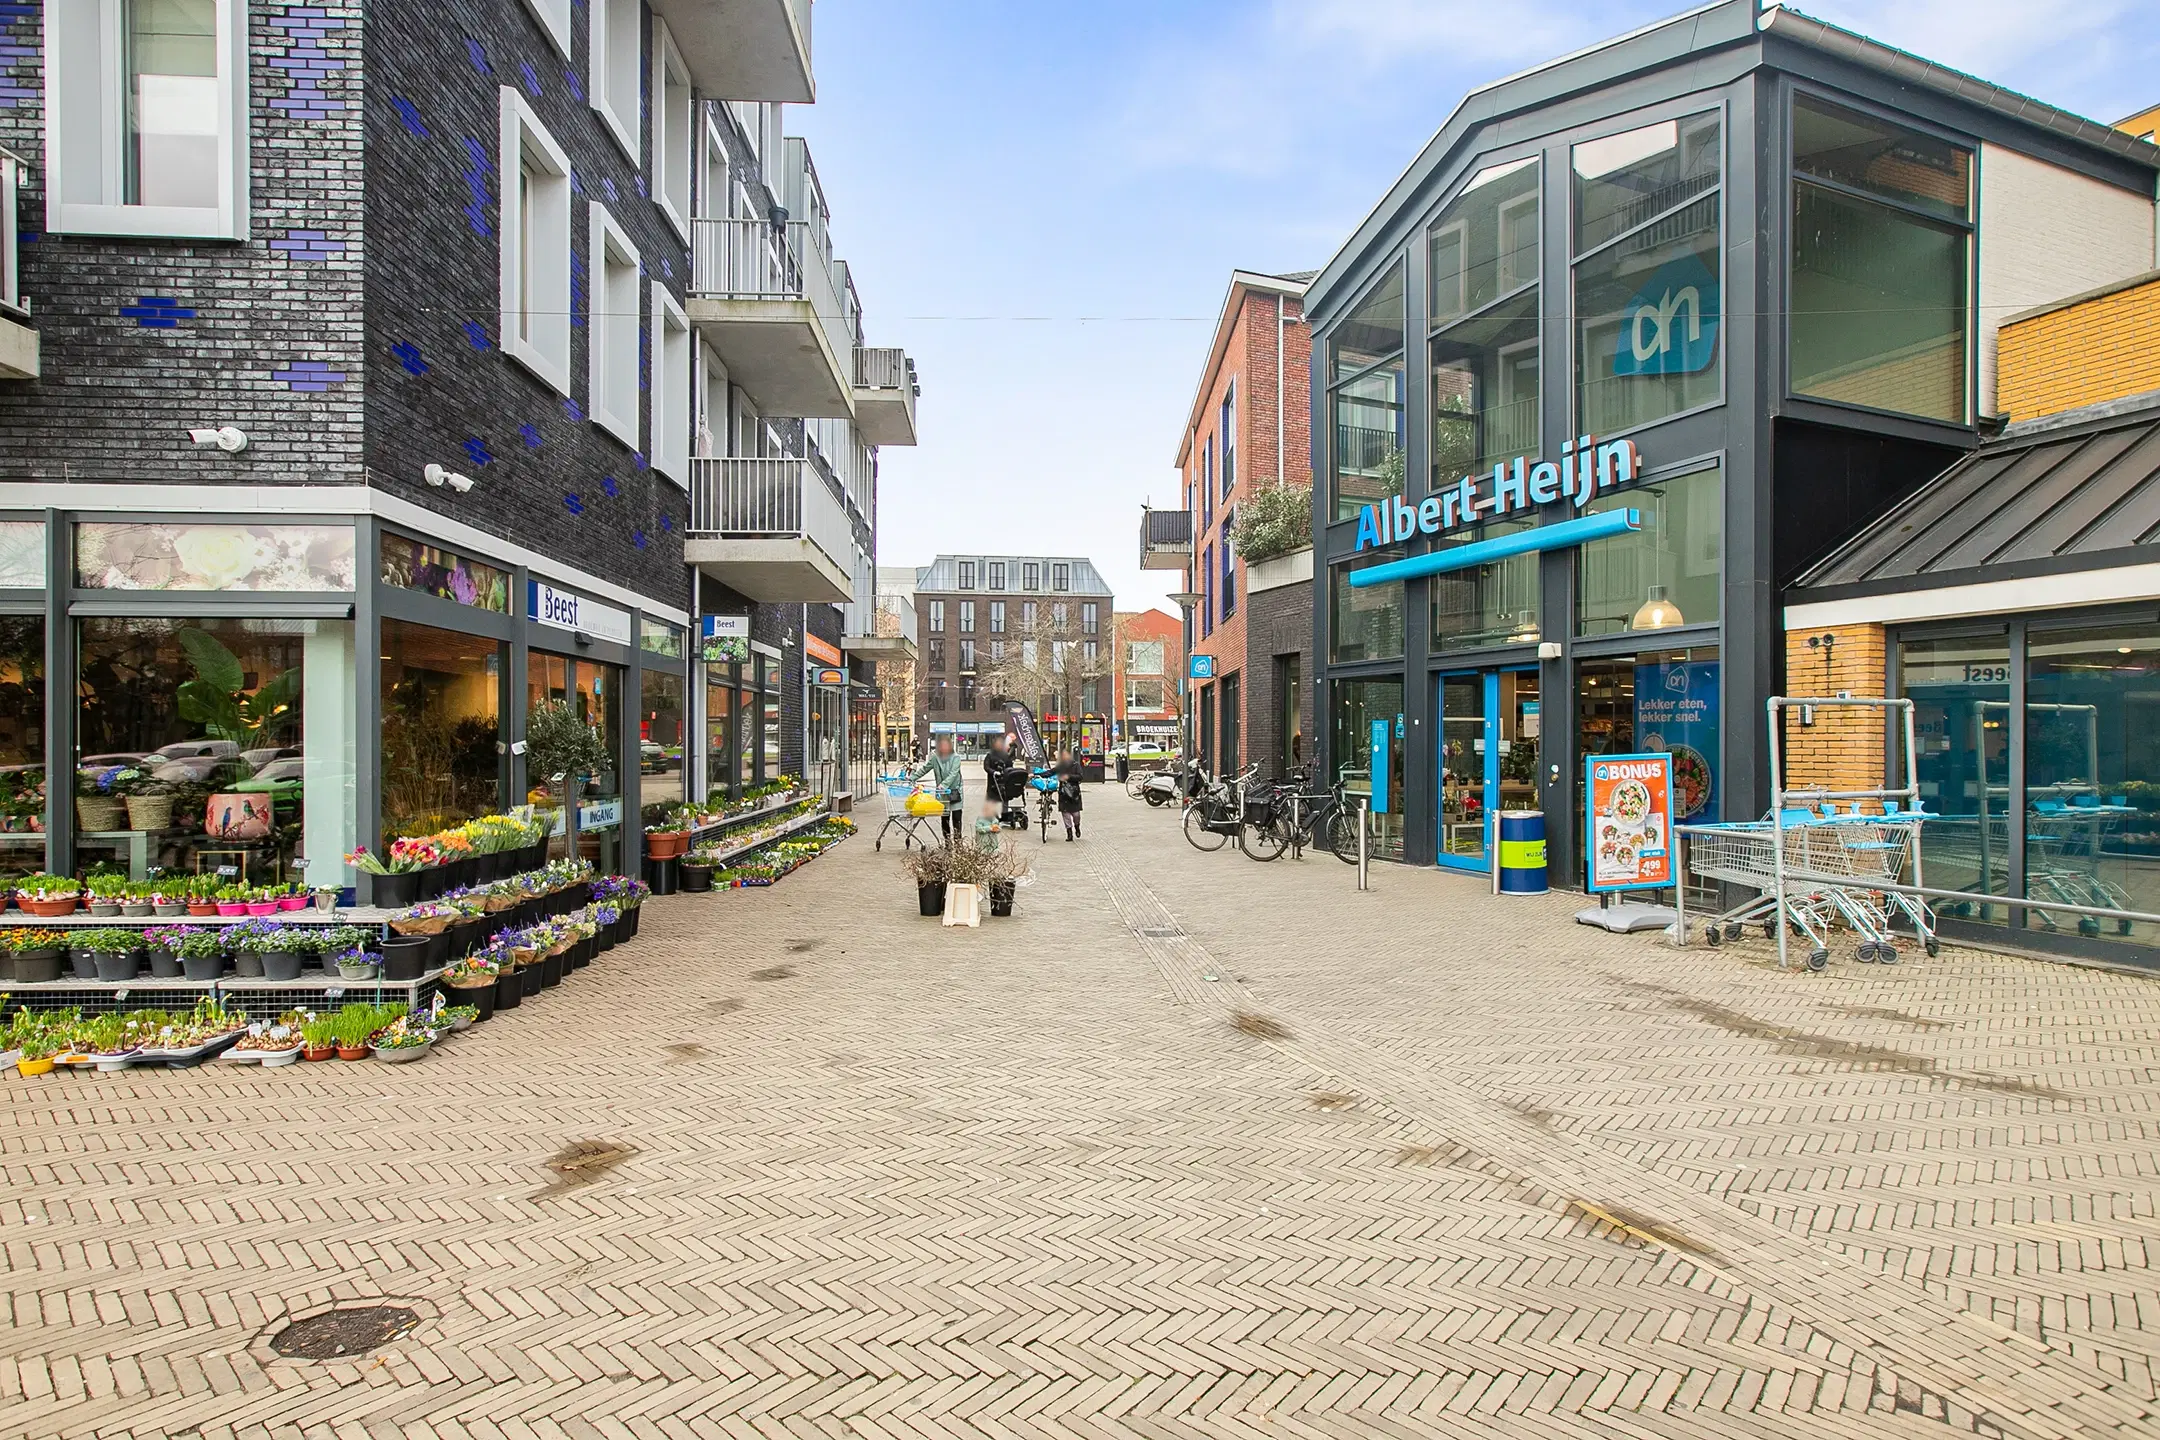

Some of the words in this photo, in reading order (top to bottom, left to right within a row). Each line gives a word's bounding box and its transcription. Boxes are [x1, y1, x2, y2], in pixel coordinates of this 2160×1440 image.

[1355, 475, 1482, 552] Albert
[1494, 434, 1638, 508] Heijn
[545, 586, 578, 626] Beest
[716, 619, 735, 628] Beest
[1638, 699, 1676, 710] Lekker
[1678, 699, 1707, 711] eten,
[1638, 711, 1673, 722] lekker
[1675, 710, 1701, 722] snel.
[1136, 725, 1180, 733] BROEKHUIZE
[1609, 763, 1662, 780] BONUS
[589, 808, 614, 823] INGANG
